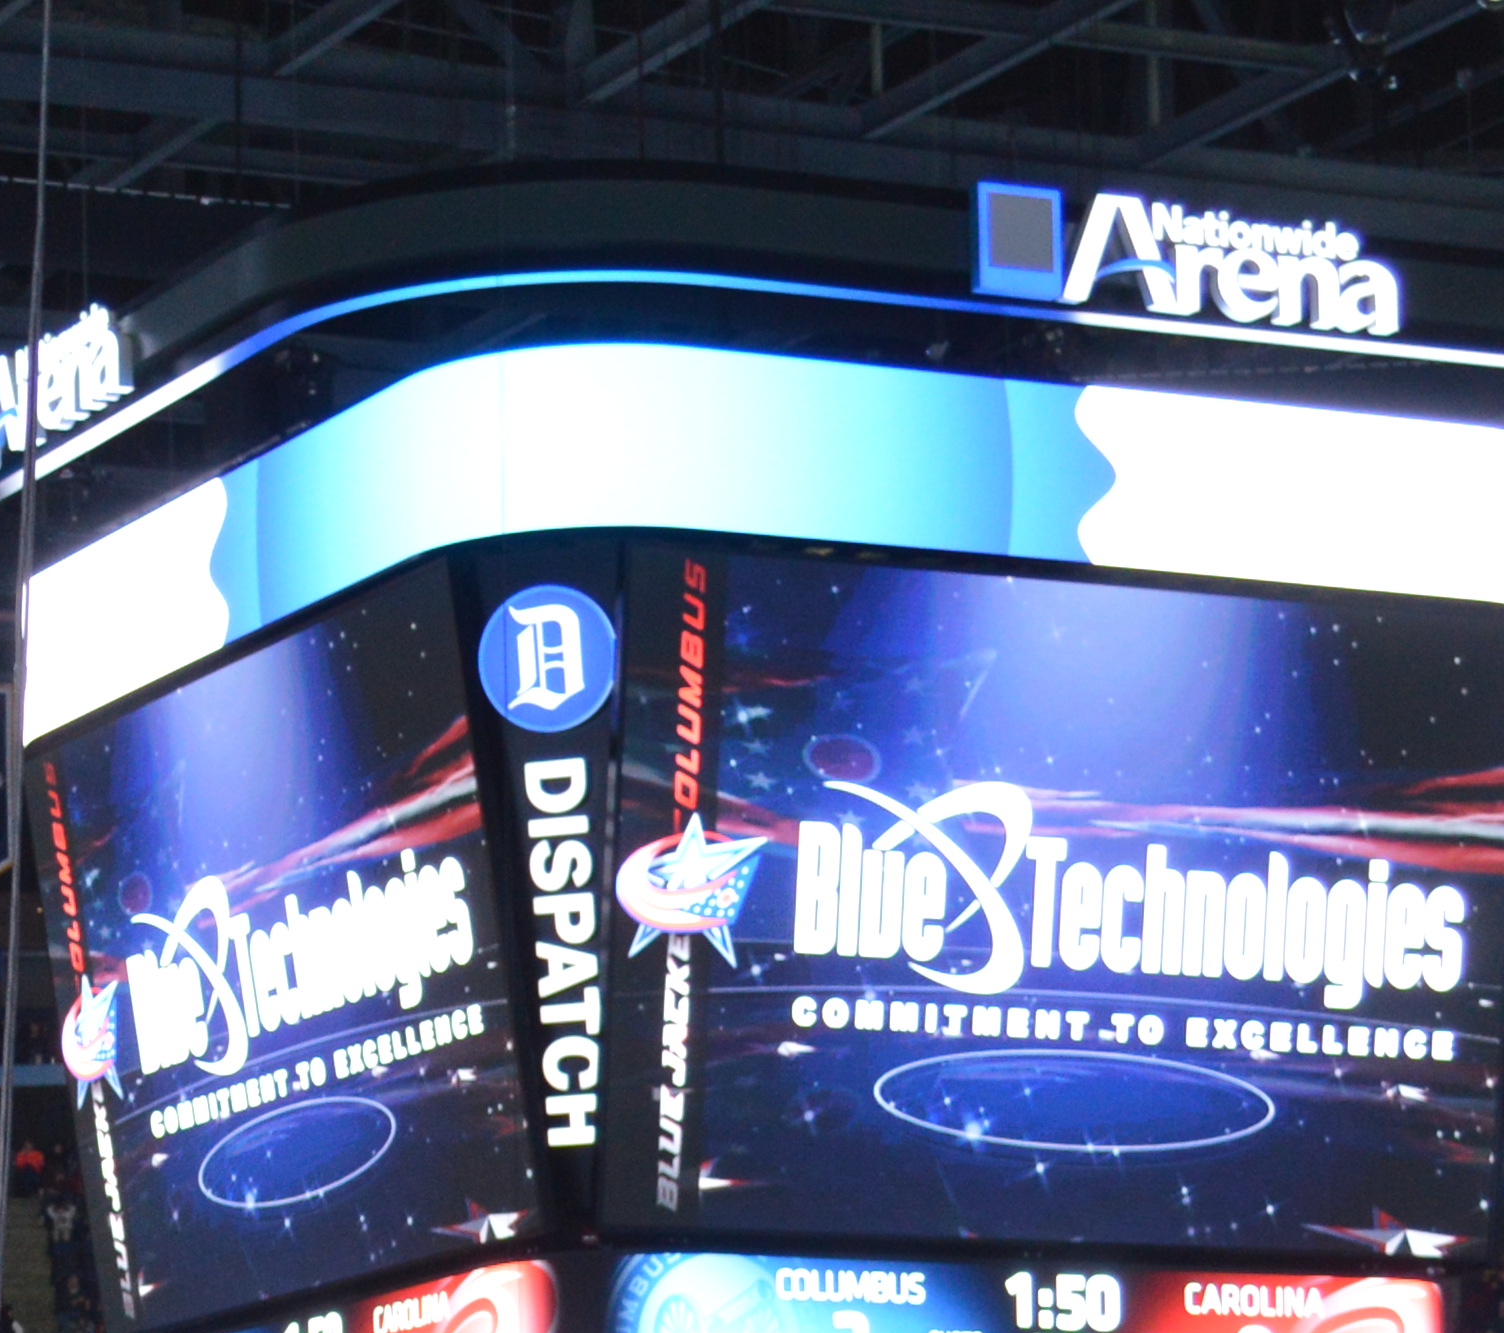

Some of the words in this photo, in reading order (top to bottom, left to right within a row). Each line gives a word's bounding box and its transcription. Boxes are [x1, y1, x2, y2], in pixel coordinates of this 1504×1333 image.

[1062, 192, 1399, 336] Arena
[1151, 201, 1359, 261] Nationwide
[44, 760, 86, 984] OLUMBUS
[794, 819, 946, 962] Blue
[1026, 837, 1465, 1009] Technologies
[229, 848, 474, 1038] Technologies
[525, 757, 601, 1148] DISPATCH
[149, 1067, 290, 1140] COMMITMENT
[299, 1056, 328, 1091] TO
[334, 1003, 484, 1081] EXCELLENCE
[791, 995, 1092, 1041] COMMITMENT
[1110, 1012, 1164, 1046] TO
[1185, 1016, 1456, 1062] EXCELLENCE
[775, 1267, 927, 1306] COLUMBUS
[1004, 1272, 1122, 1332] 1:50
[1184, 1281, 1326, 1319] CAROLINA
